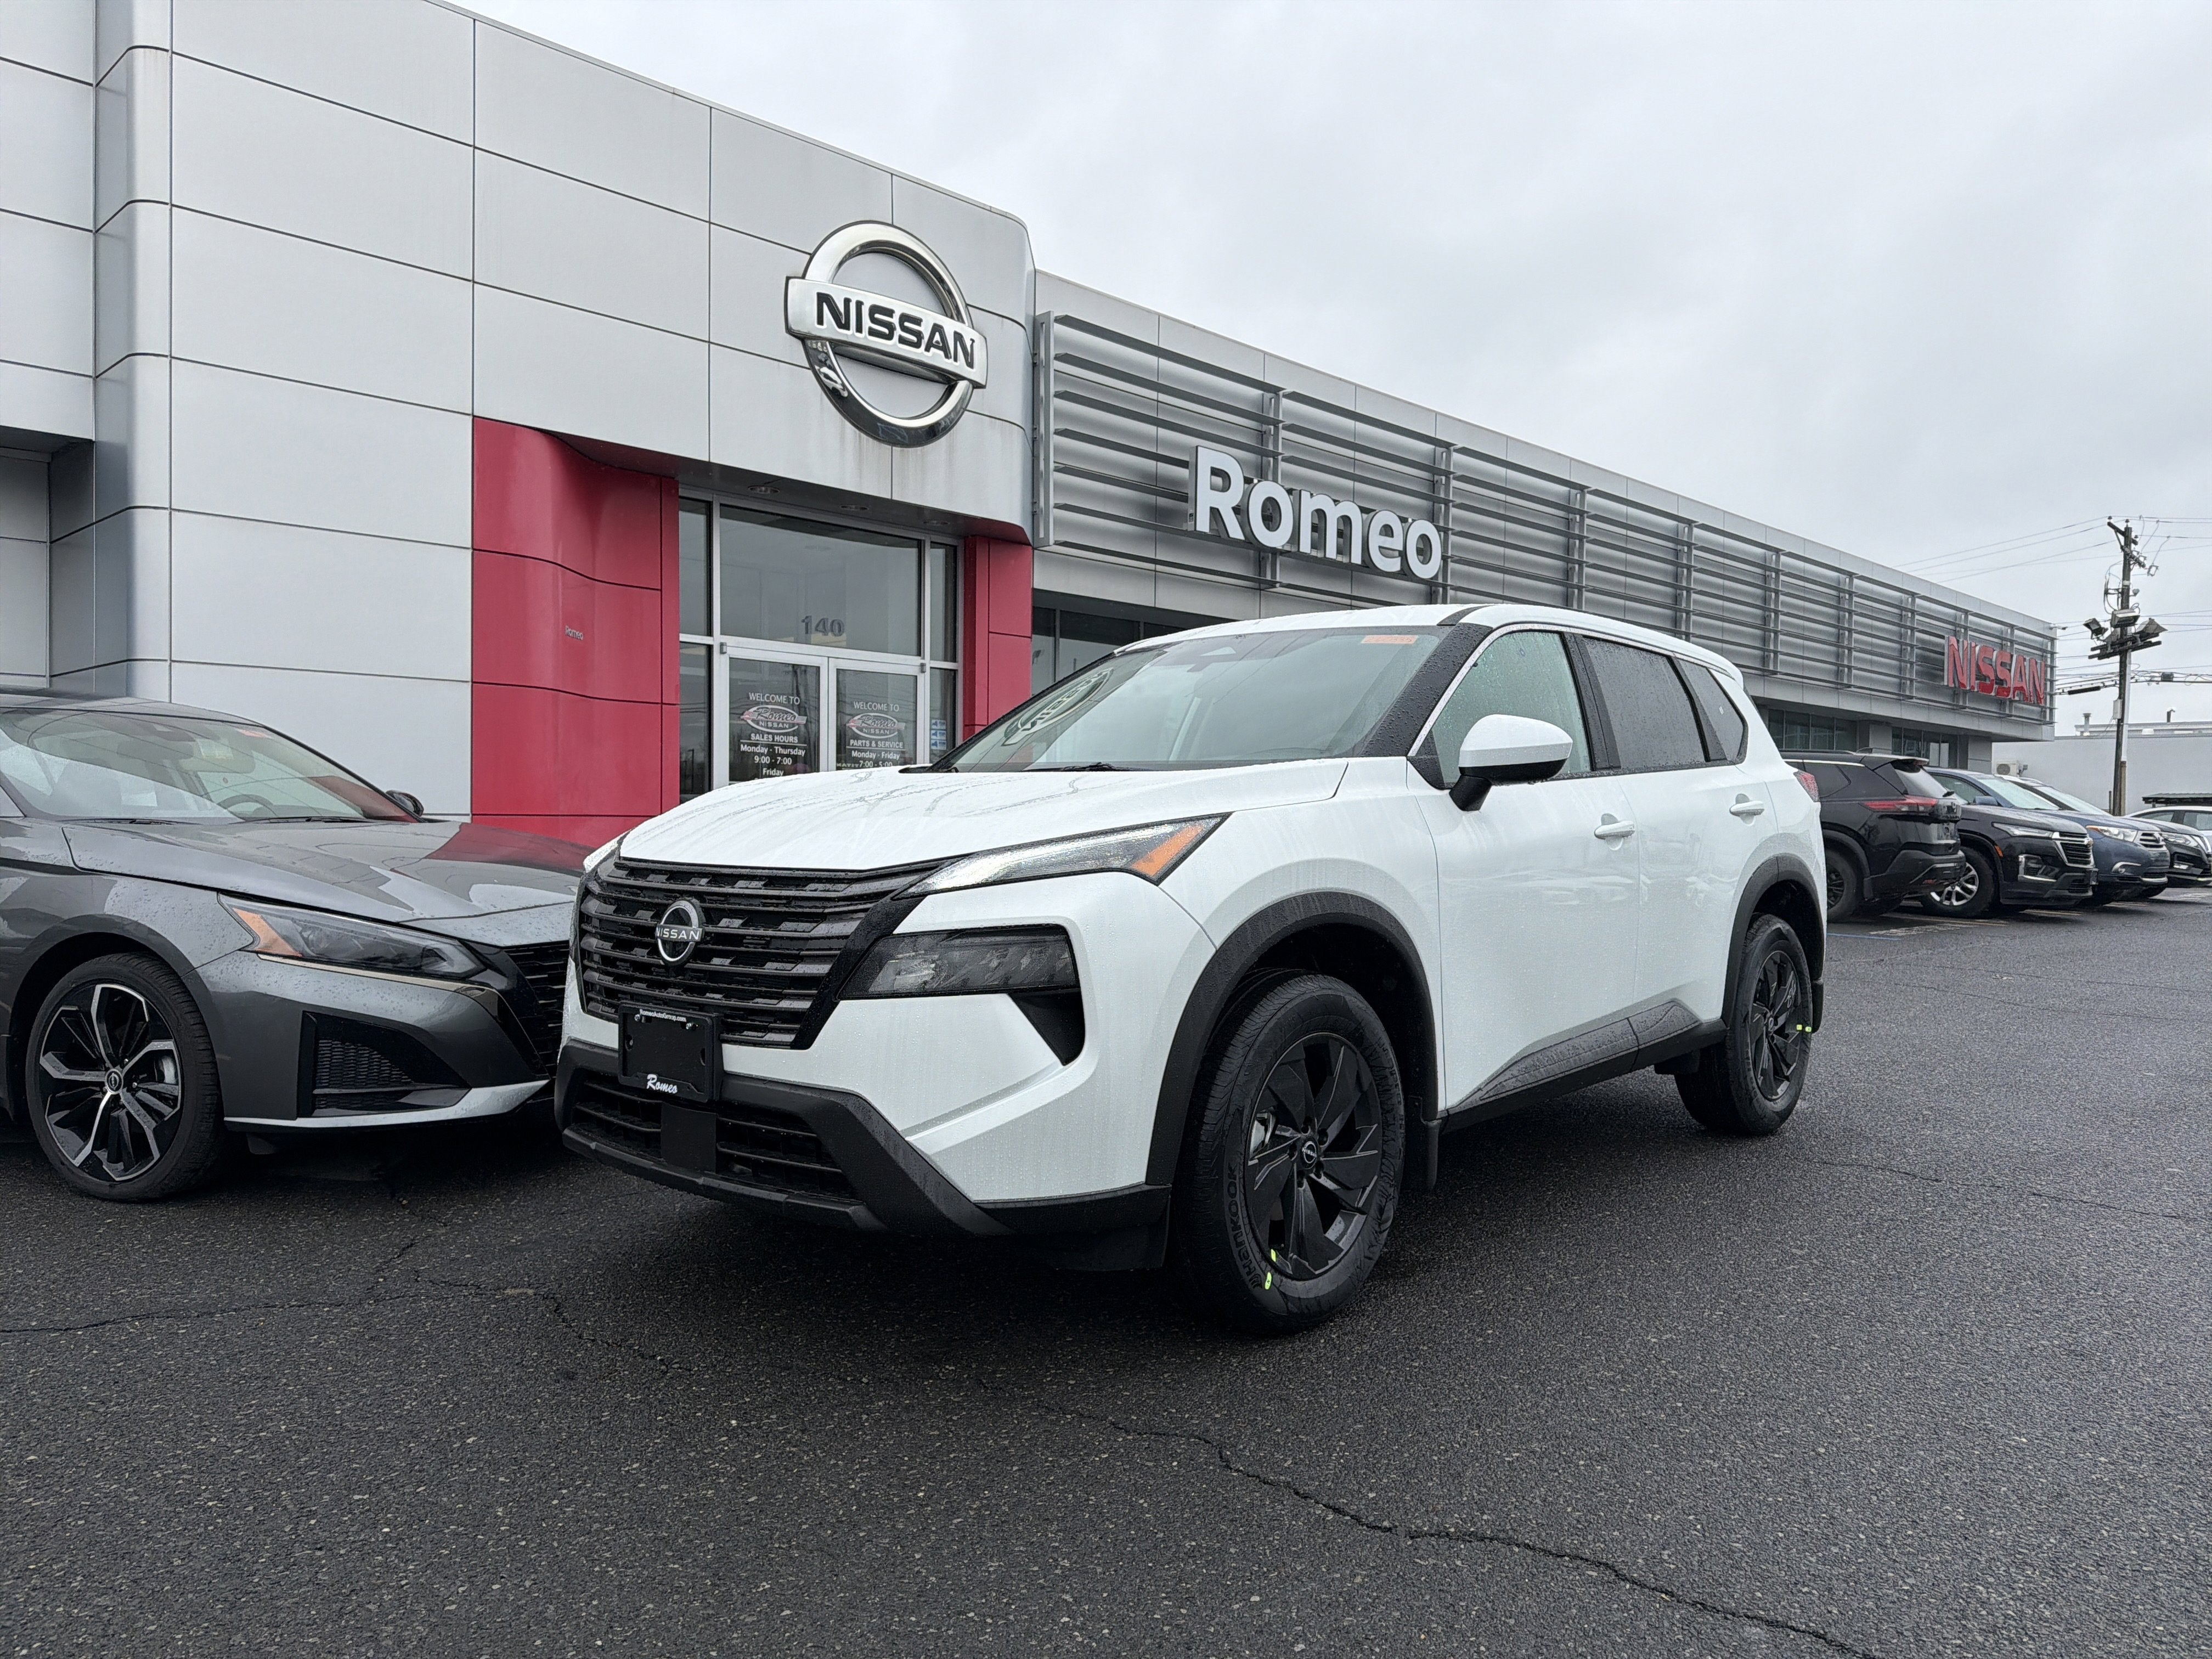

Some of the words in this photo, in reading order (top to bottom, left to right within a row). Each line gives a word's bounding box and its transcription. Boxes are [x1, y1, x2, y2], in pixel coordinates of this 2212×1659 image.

[816, 291, 975, 370] NISSAN
[1194, 444, 1442, 579] Romeo
[801, 615, 845, 637] 140
[565, 625, 584, 641] Romeo
[1947, 635, 2046, 706] NISSAN
[748, 692, 788, 704] WELCOME
[789, 696, 800, 705] TO
[853, 701, 888, 711] WELCOME
[889, 703, 900, 712] TO
[753, 706, 797, 721] Romeo
[759, 720, 789, 729] NISSAN
[857, 714, 896, 728] Romeo
[751, 733, 773, 742] SALES
[774, 735, 798, 743] HOURS
[850, 739, 870, 747] PARTS
[741, 744, 769, 754] Monday
[774, 746, 806, 757] Thursday
[851, 750, 877, 760] Monday
[881, 751, 900, 760] Friday
[754, 755, 770, 764] 9:00
[776, 757, 792, 765] 7:00
[762, 768, 784, 777] Friday
[655, 926, 700, 940] NISSAN
[646, 1074, 678, 1094] Romeo
